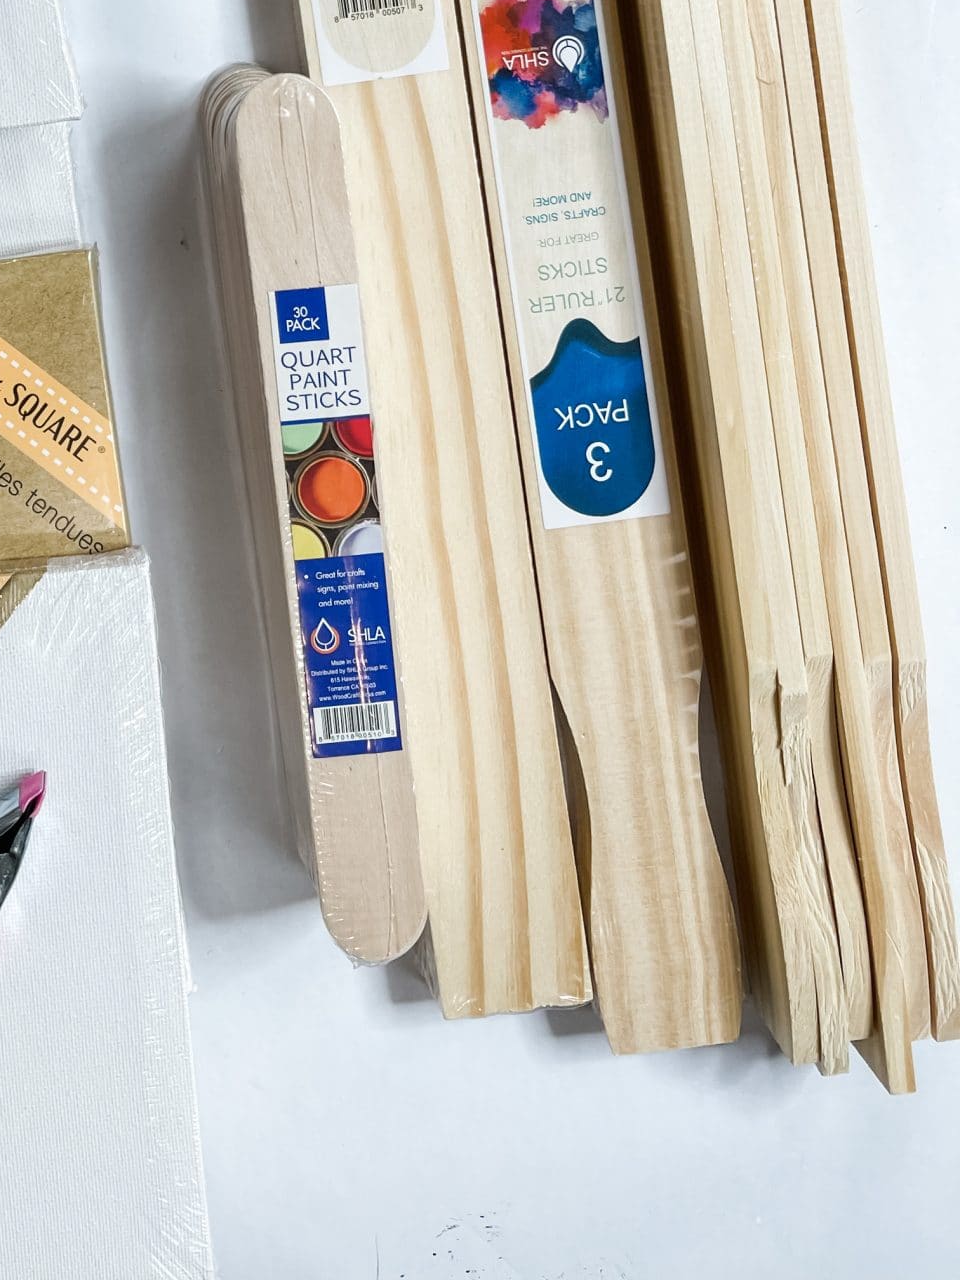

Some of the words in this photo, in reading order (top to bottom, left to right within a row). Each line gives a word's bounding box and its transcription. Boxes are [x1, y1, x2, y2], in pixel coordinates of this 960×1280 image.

[382, 6, 405, 17] 00507
[502, 51, 549, 70] SHLA
[532, 195, 567, 207] MORE!
[569, 191, 592, 203] AND
[564, 231, 600, 245] GREAT
[537, 257, 608, 281] STICKS
[293, 306, 308, 318] 30
[286, 317, 320, 332] PACK
[281, 346, 356, 371] QUART
[290, 369, 351, 390] PAINT
[286, 389, 361, 411] STICKS
[3, 383, 97, 463] SQUARE
[555, 399, 629, 430] PACK
[586, 441, 613, 482] 3
[25, 488, 104, 554] tendues
[315, 572, 335, 580] Great
[356, 581, 378, 590] mixing
[318, 598, 332, 607] and
[348, 626, 385, 643] SHLA
